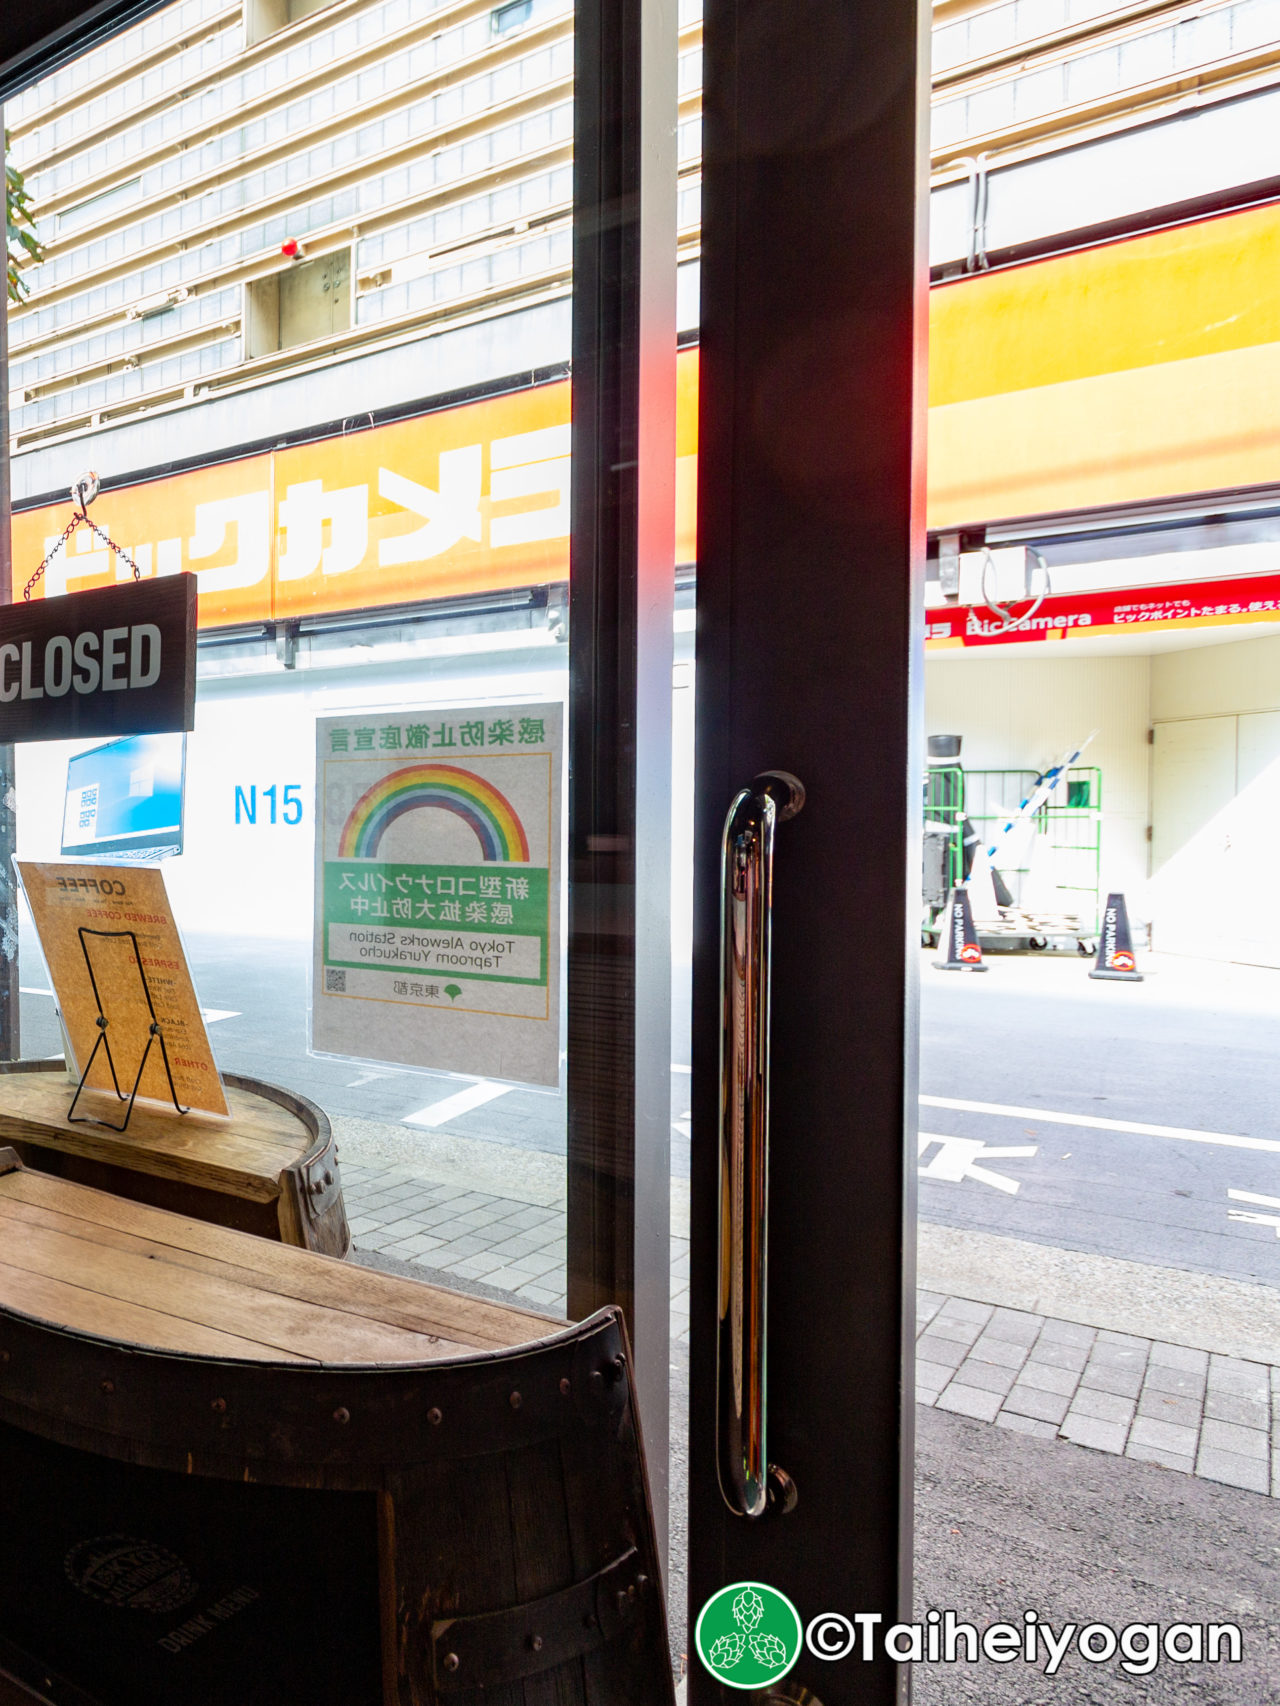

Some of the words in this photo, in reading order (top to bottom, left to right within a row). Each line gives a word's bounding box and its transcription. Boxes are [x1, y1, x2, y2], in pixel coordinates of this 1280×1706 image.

[234, 784, 303, 825] N15
[954, 904, 963, 918] NO
[1106, 908, 1117, 923] NO
[158, 1613, 219, 1654] DRINK
[207, 1584, 262, 1622] MENU
